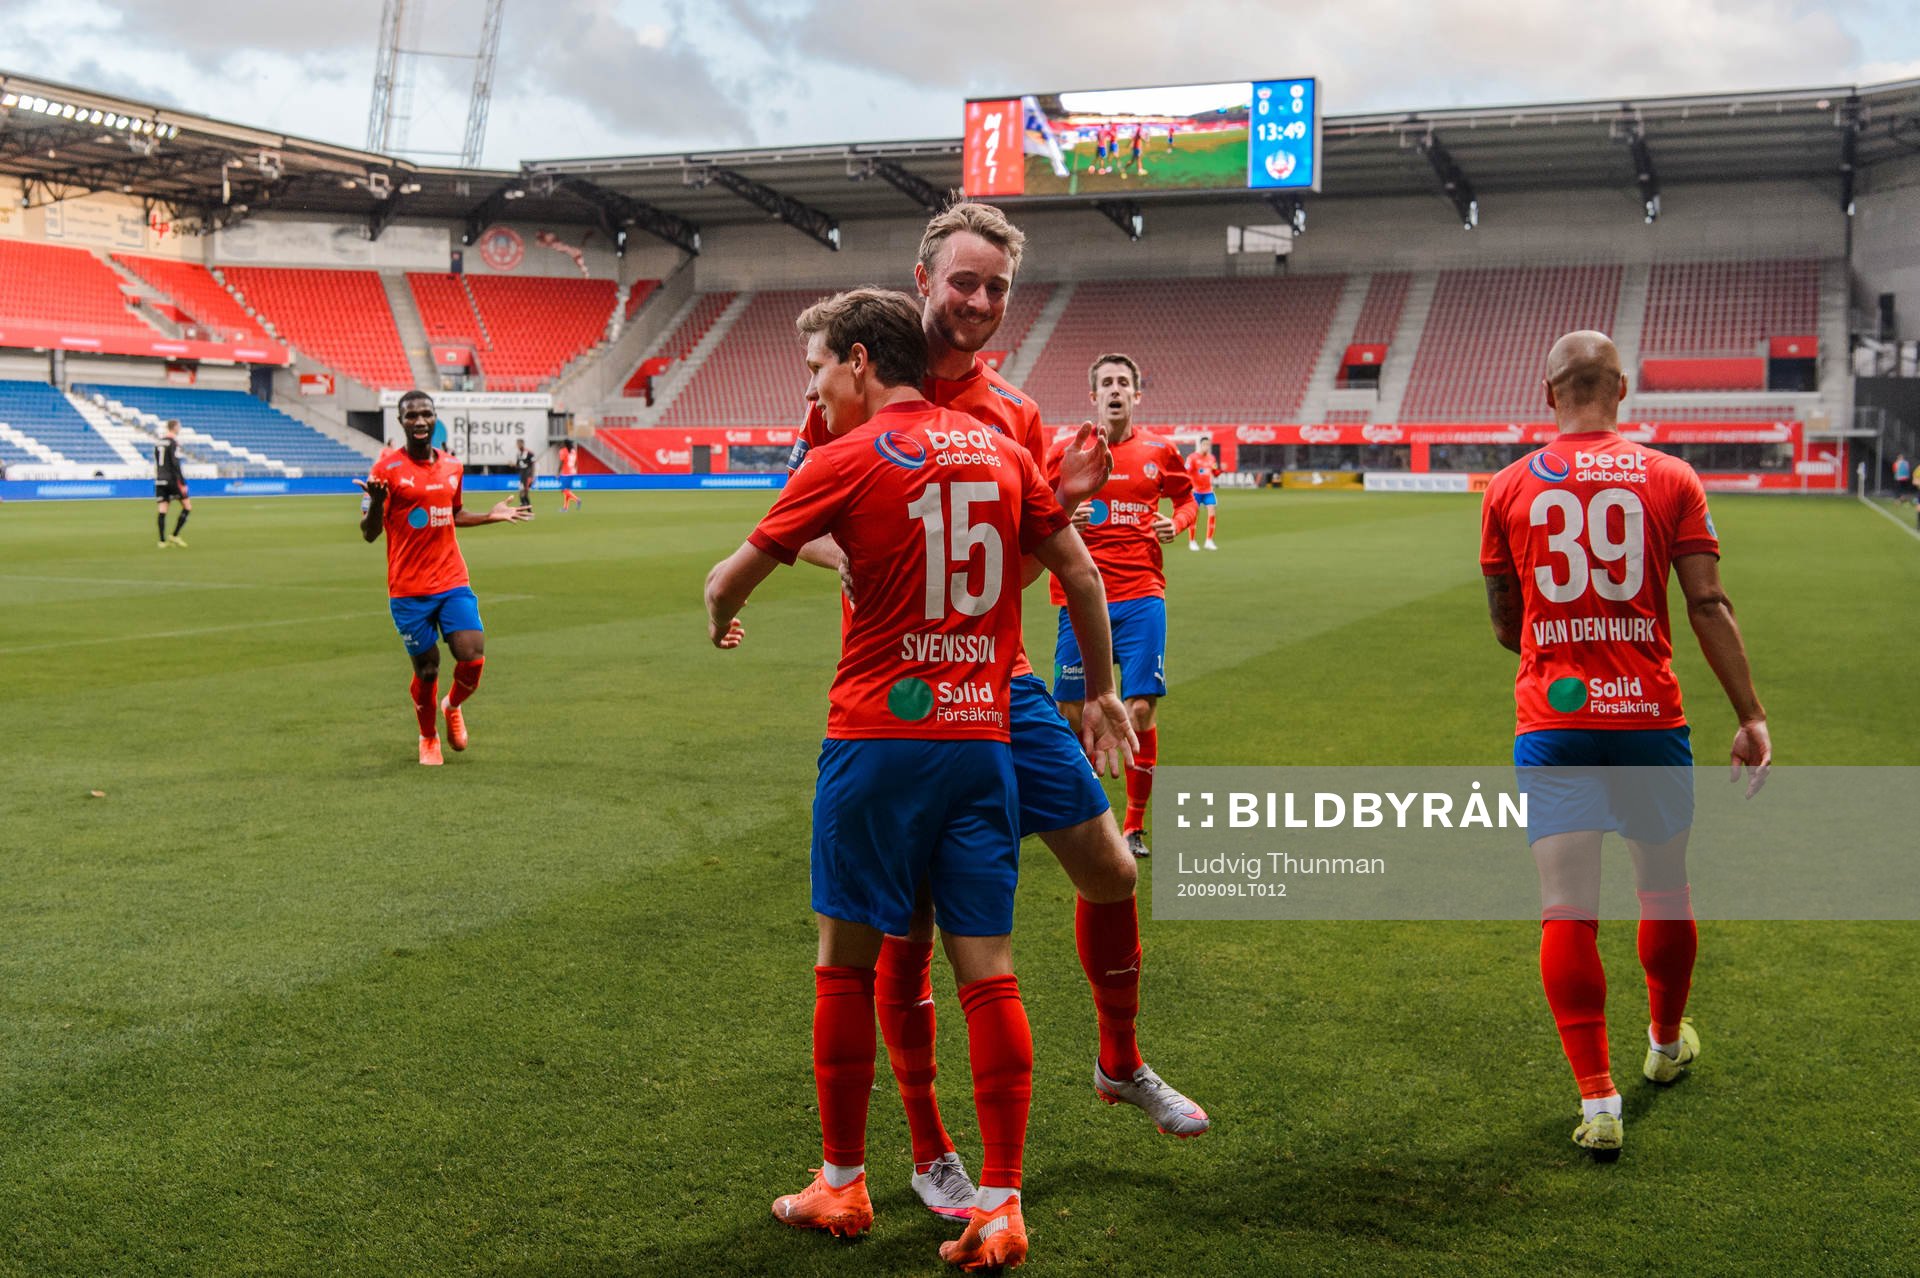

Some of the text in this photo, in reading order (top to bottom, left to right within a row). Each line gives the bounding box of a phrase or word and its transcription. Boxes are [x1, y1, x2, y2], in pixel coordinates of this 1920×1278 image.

[1259, 99, 1269, 115] 0
[1292, 98, 1303, 114] 0
[1257, 120, 1306, 141] 13:49
[454, 416, 525, 435] Resurs
[454, 437, 504, 455] Bank
[925, 427, 997, 451] beat
[936, 450, 1002, 467] diabetes
[1575, 451, 1646, 470] beat
[1575, 469, 1646, 483] diabetes
[430, 505, 453, 516] Resu
[1111, 499, 1149, 513] Resurs
[1111, 512, 1141, 525] Bank
[907, 481, 1003, 620] 15
[1529, 487, 1645, 603] 39
[1532, 617, 1657, 646] VAN DEN HURK
[937, 681, 994, 703] Solid
[1589, 676, 1643, 697] Solid
[936, 706, 1003, 728] Försäkring
[1590, 700, 1661, 717] Försäkring
